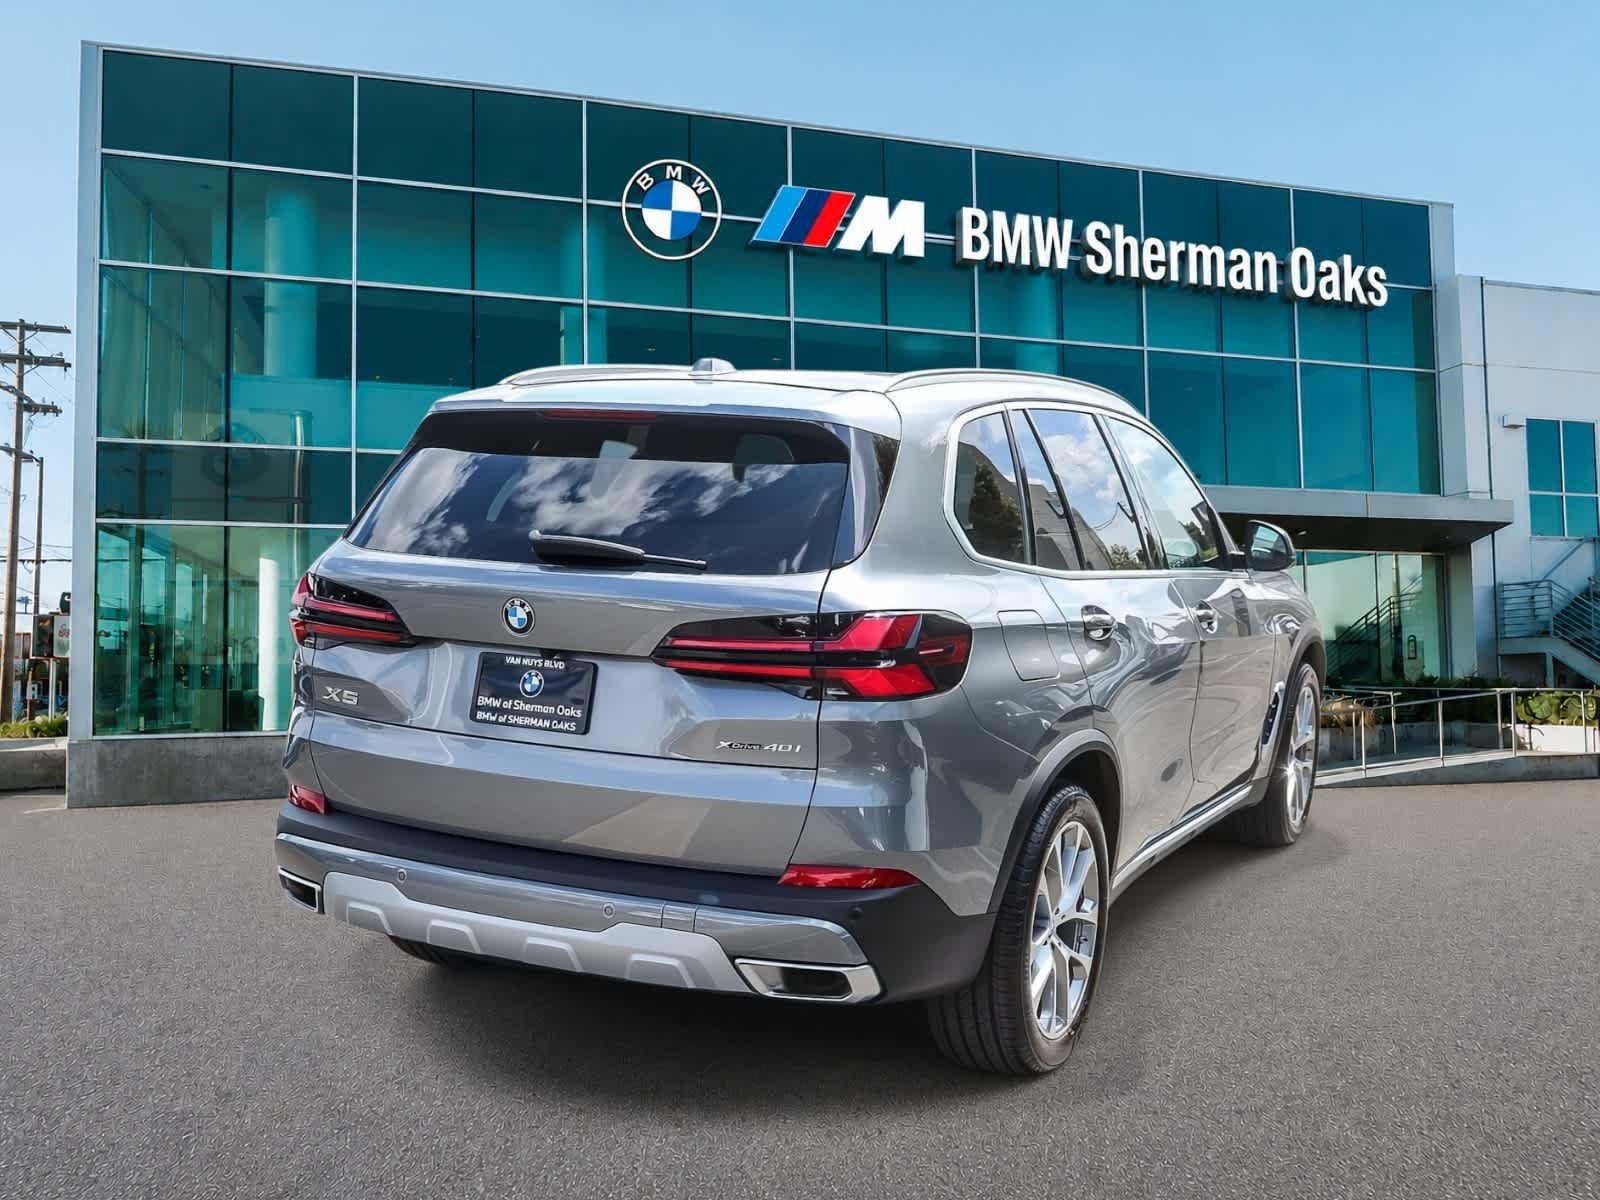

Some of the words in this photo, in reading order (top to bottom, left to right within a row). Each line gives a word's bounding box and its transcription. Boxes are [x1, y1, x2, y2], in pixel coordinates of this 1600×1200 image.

[637, 165, 710, 196] BMW
[960, 206, 1073, 270] BMW
[1085, 220, 1278, 294] Sherman
[1290, 246, 1389, 308] Oaks
[505, 656, 521, 665] VAN
[522, 658, 543, 668] NUYS
[544, 660, 565, 670] BLVD
[322, 686, 359, 705] X5
[477, 696, 501, 708] BMW
[503, 699, 514, 709] of
[514, 699, 555, 714] Sherman
[557, 704, 582, 718] Oaks
[476, 711, 498, 722] BMW
[498, 714, 507, 723] of
[507, 714, 550, 728] SHERMAN
[552, 721, 577, 732] OAKS
